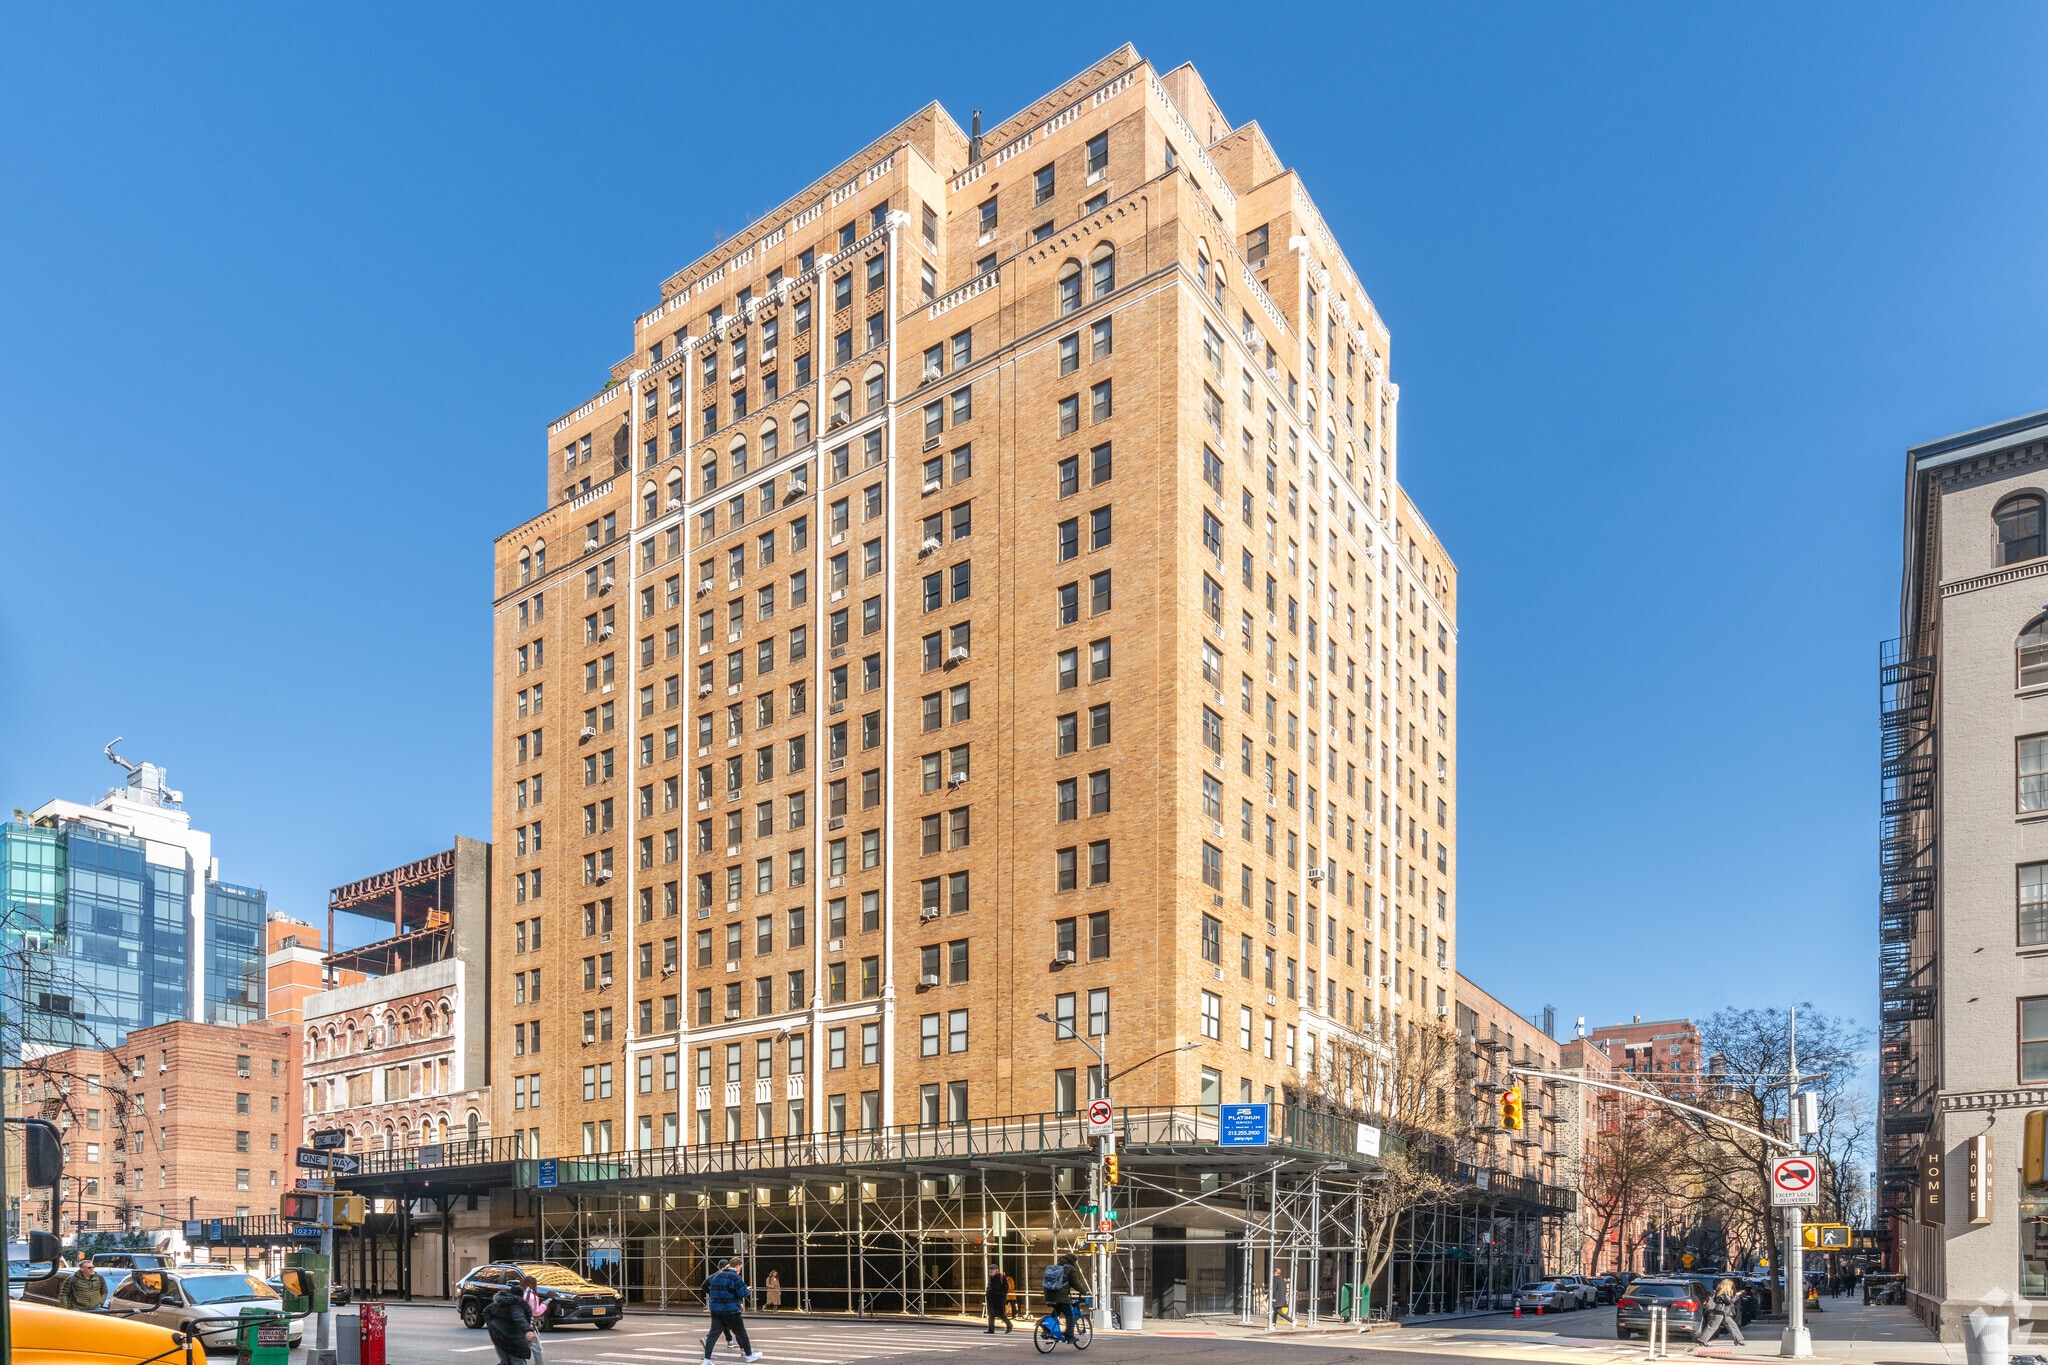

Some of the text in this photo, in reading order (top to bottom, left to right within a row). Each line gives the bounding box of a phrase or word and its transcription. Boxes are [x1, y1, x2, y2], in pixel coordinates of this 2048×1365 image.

[316, 1134, 342, 1145] ONE WAY
[302, 1154, 352, 1168] ONE WAY
[1928, 1153, 1940, 1204] HOME
